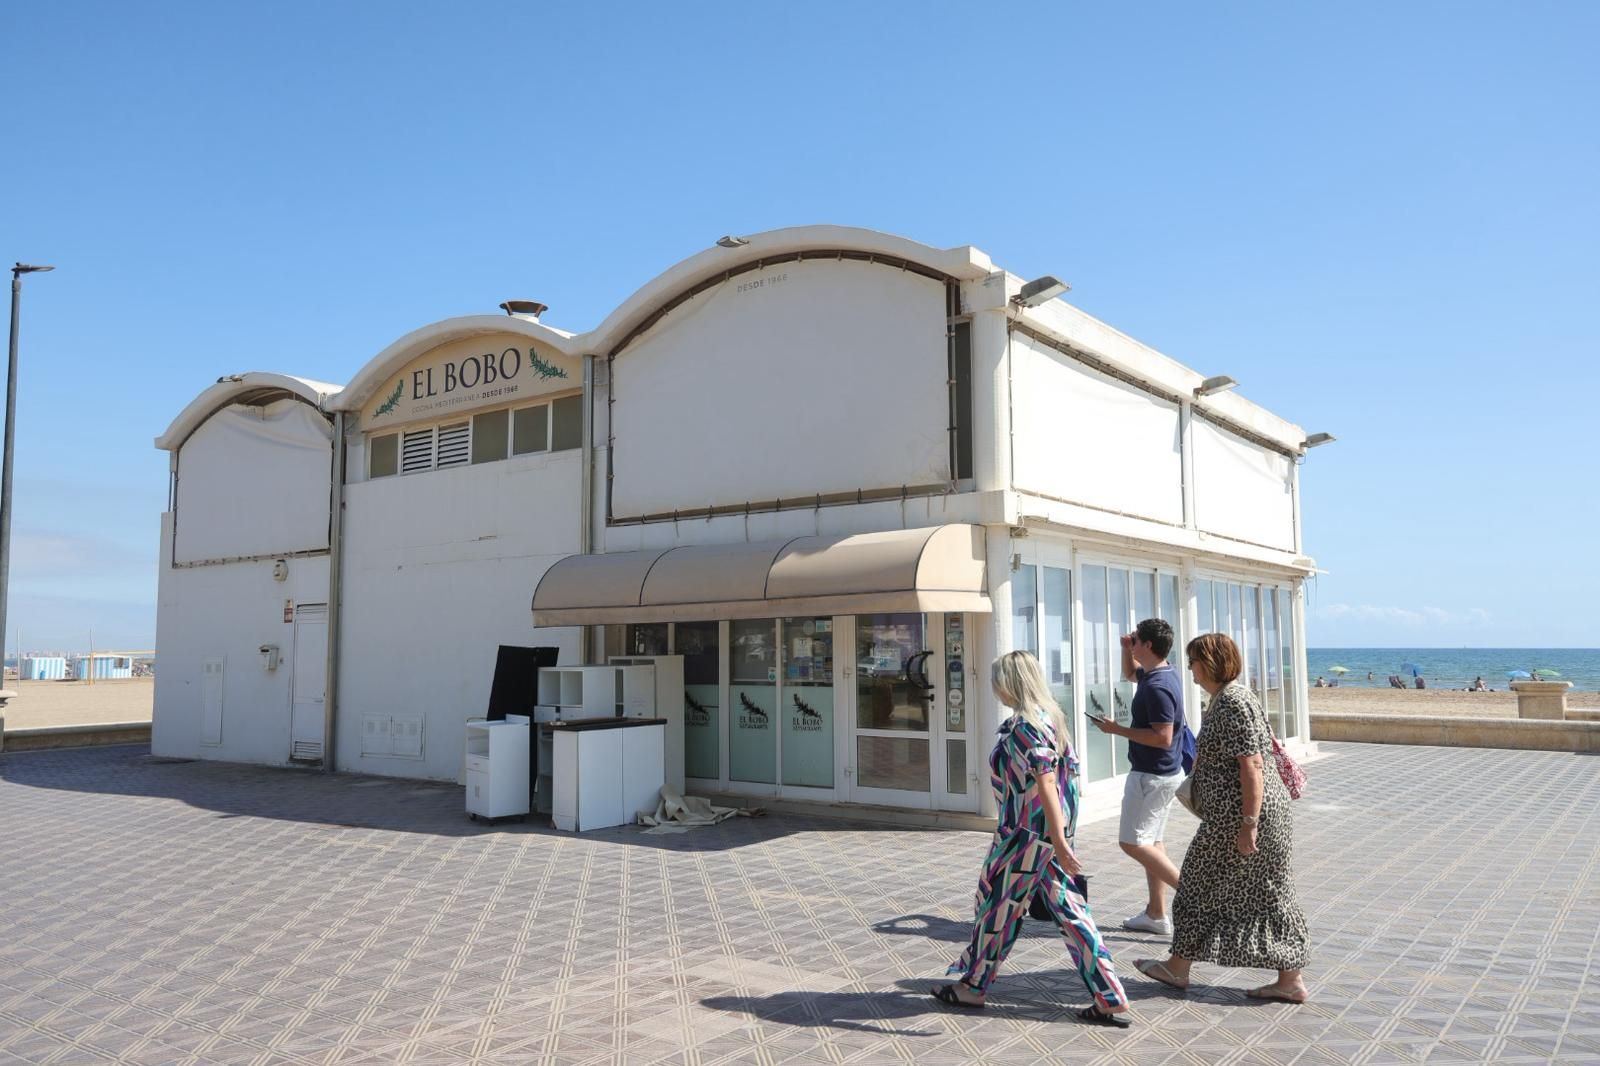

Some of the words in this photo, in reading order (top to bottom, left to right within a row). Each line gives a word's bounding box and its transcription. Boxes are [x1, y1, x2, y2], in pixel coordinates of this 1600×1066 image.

[738, 280, 764, 292] DESDE
[412, 368, 437, 400] EL
[444, 348, 520, 392] BOBO
[482, 388, 503, 399] DESDE
[739, 716, 747, 724] EL
[749, 716, 769, 724] BOBO
[792, 717, 800, 725] EL
[802, 717, 823, 726] BOBO
